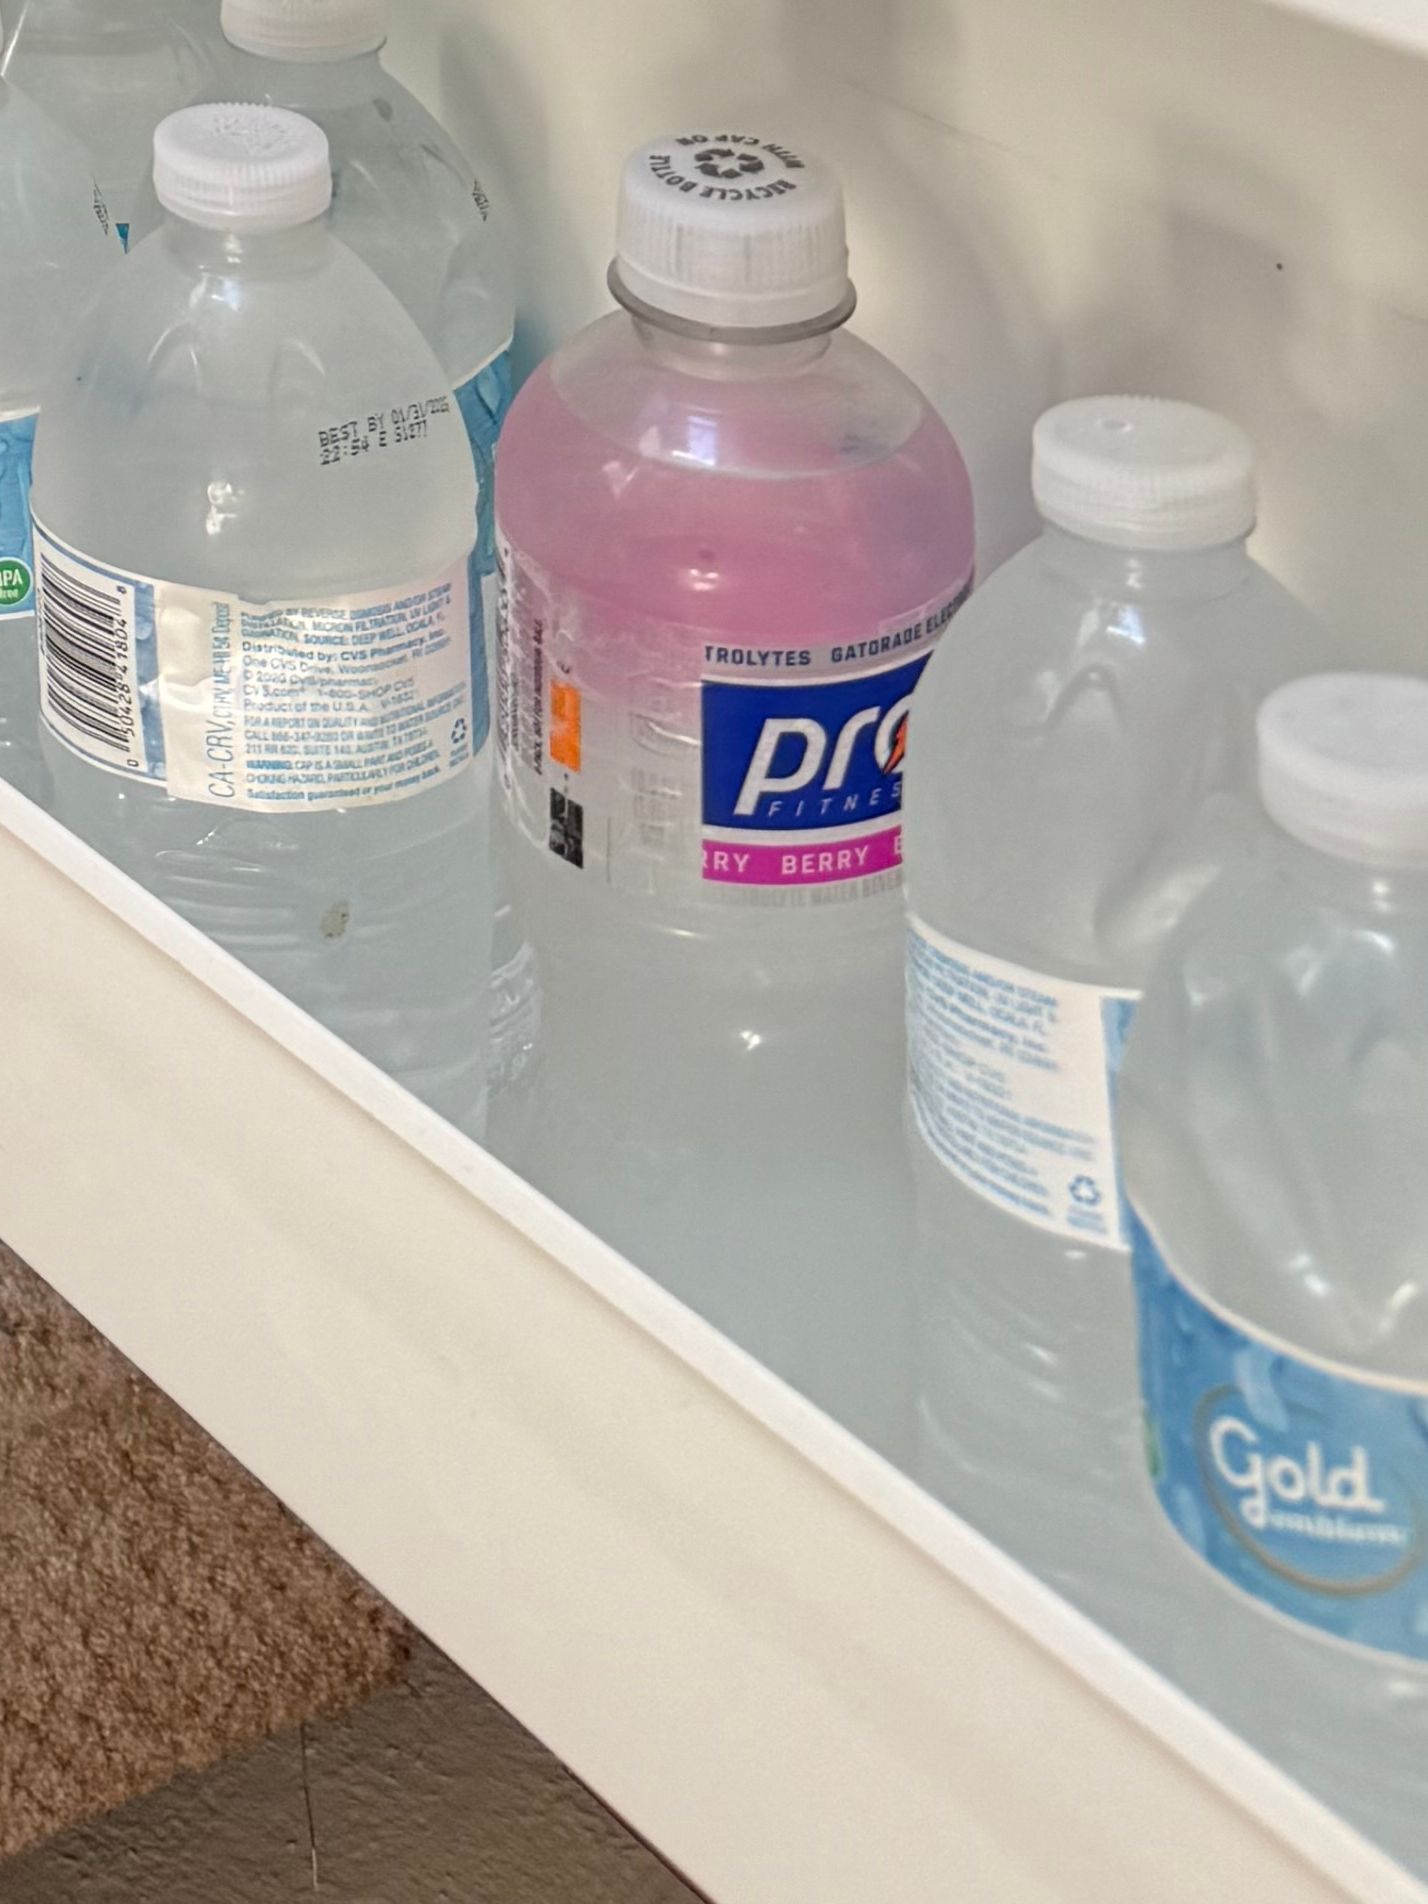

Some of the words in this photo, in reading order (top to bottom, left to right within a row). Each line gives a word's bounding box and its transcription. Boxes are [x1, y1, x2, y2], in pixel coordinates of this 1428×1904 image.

[318, 421, 358, 447] BEST
[368, 413, 385, 432] BY
[379, 430, 387, 447] E
[242, 641, 314, 660] Distributed
[340, 650, 367, 661] CVS
[705, 646, 812, 667] TROLYTES
[831, 623, 922, 663] GATORADE
[243, 654, 267, 668] One
[271, 658, 297, 671] CVS
[243, 698, 292, 712] Product
[294, 701, 307, 712] of
[310, 701, 329, 712] the
[206, 719, 236, 799] CA-CRV,
[295, 760, 313, 770] CAP
[781, 844, 869, 875] BERRY
[1209, 1415, 1387, 1531] Gold
